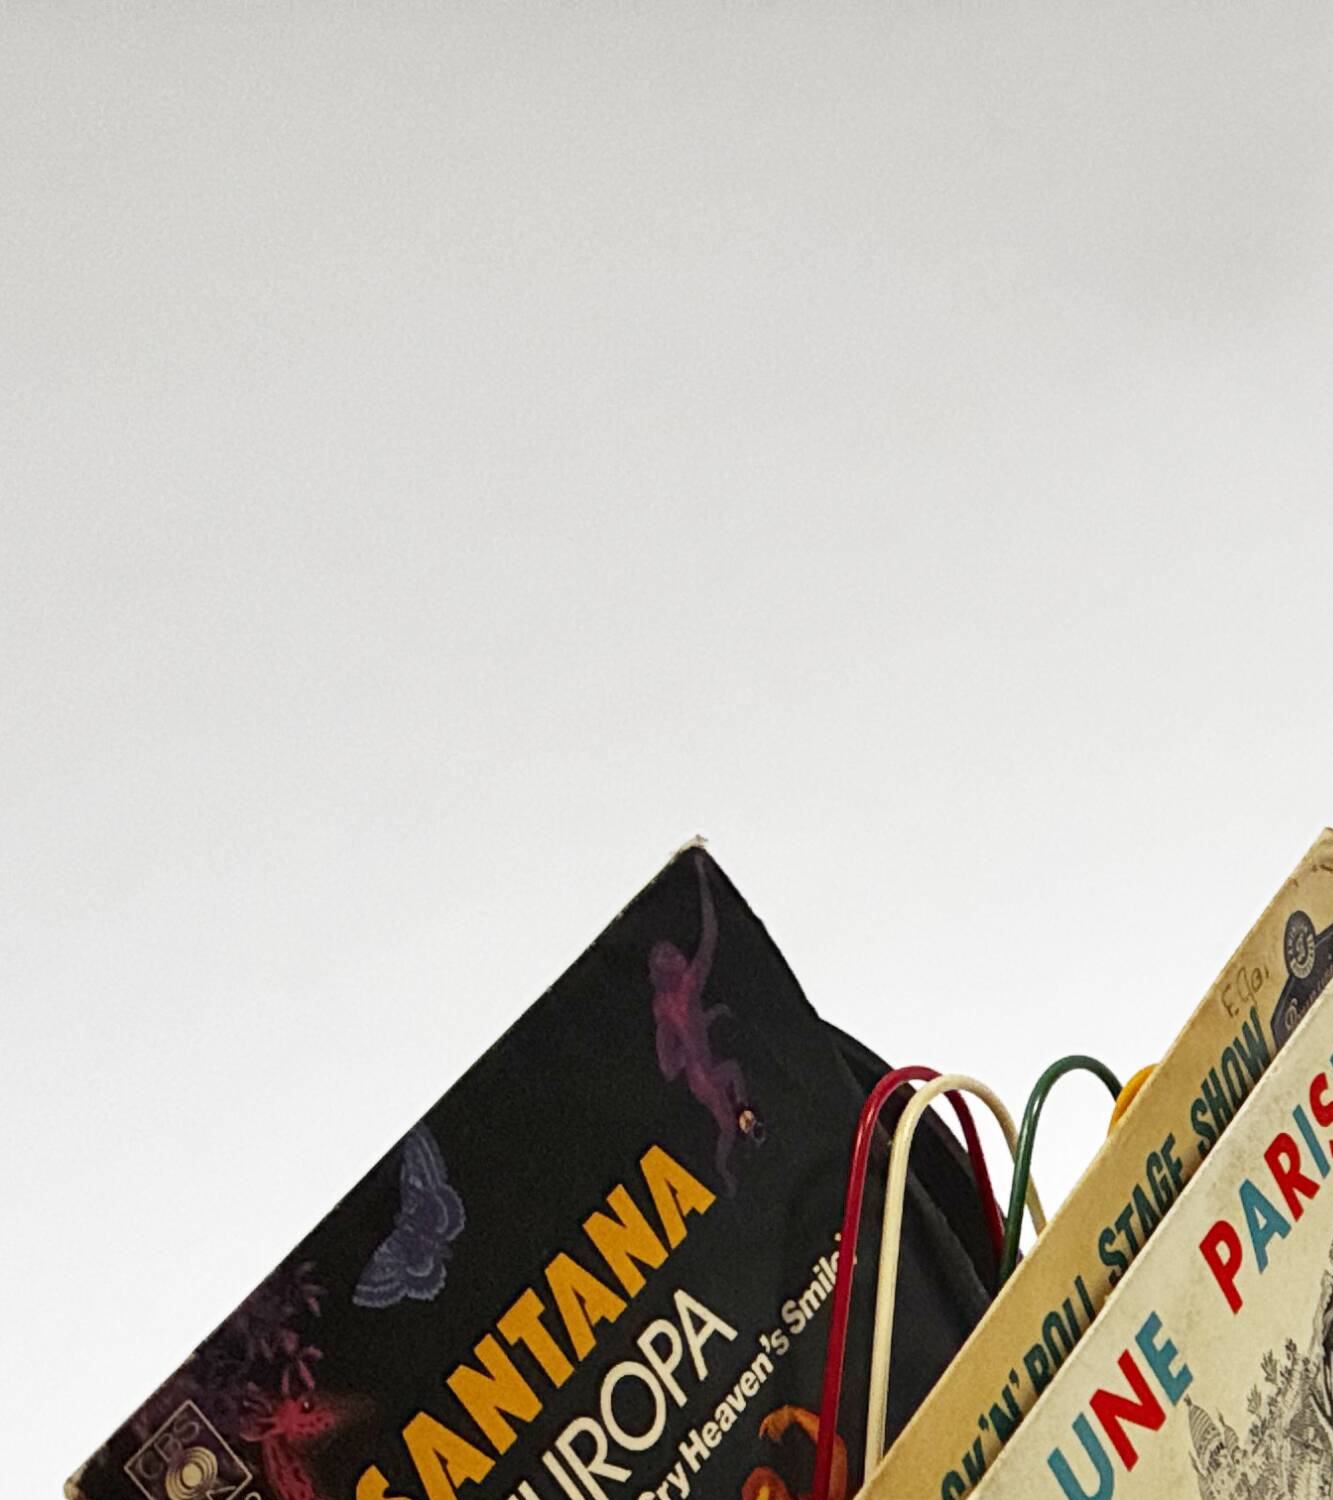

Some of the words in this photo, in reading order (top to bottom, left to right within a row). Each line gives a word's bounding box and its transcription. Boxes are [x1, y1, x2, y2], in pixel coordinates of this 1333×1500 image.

[1098, 1132, 1184, 1285] STAGE
[1190, 1005, 1271, 1159] SHOW
[133, 1412, 204, 1484] CBS
[682, 1331, 790, 1483] Heaven's
